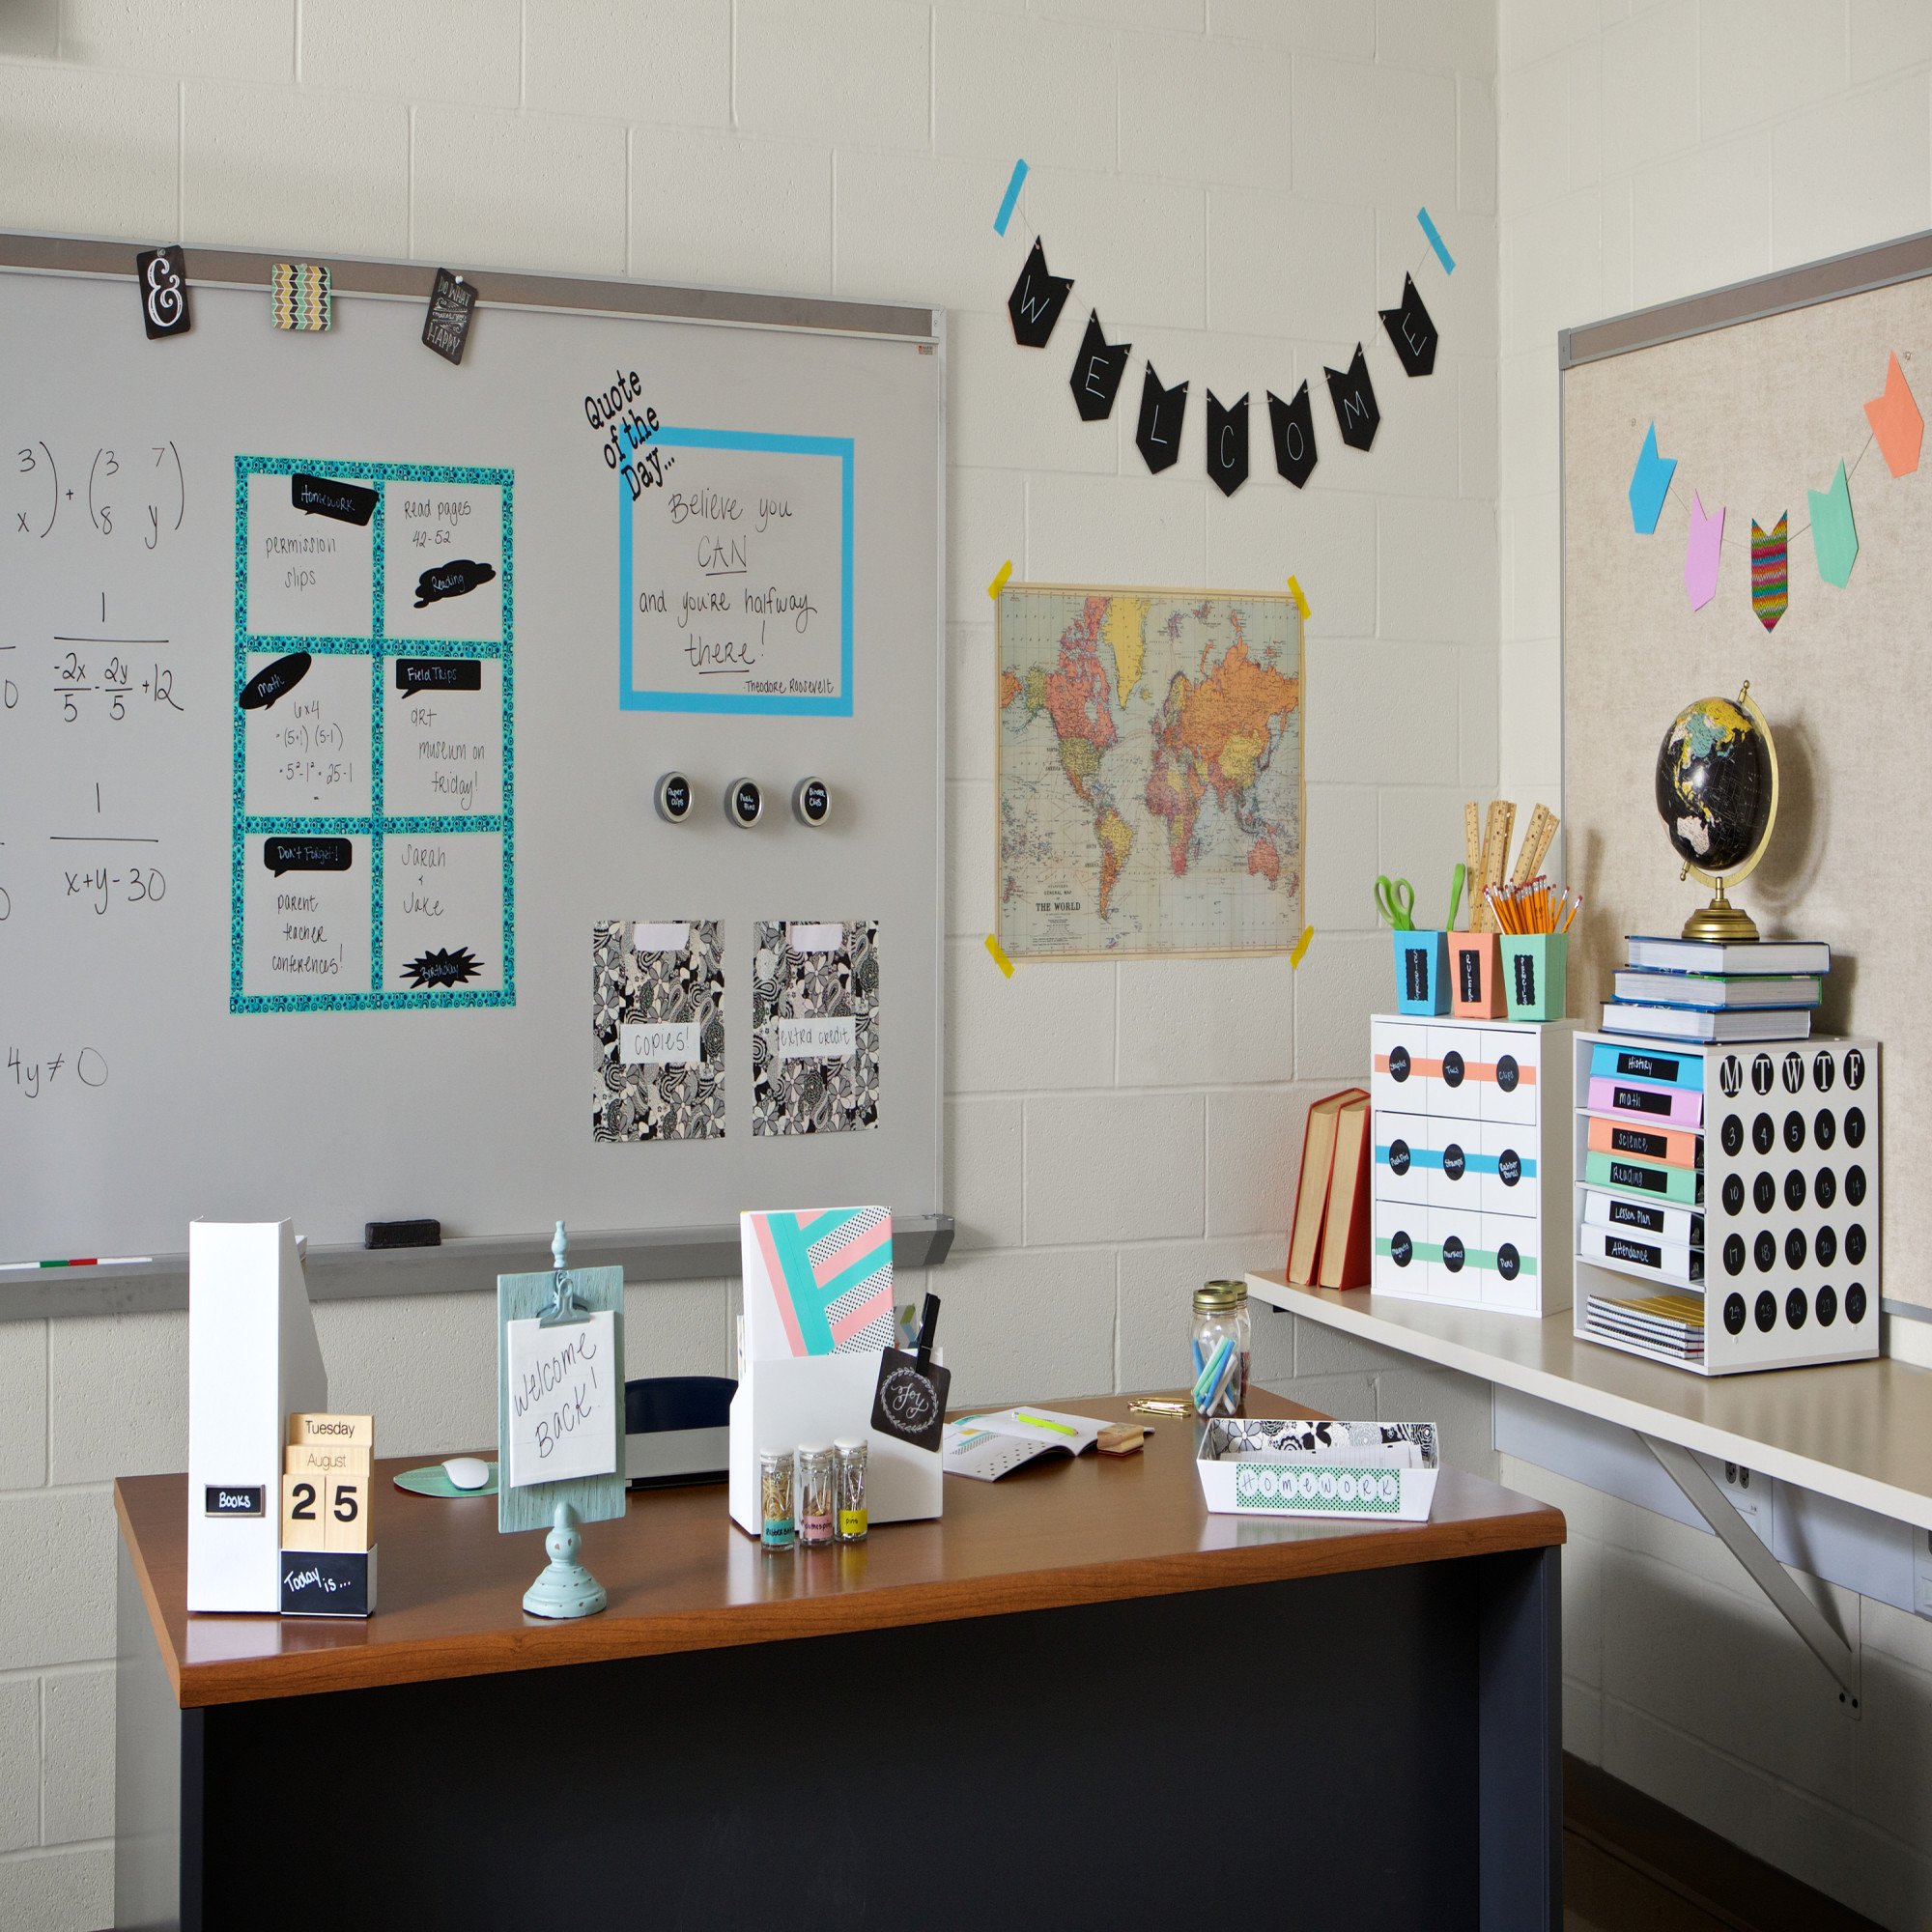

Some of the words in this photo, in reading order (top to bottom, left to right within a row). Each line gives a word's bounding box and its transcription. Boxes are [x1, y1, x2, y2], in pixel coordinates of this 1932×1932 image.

[427, 322, 461, 355] HAPPY
[583, 369, 642, 430] Quote
[604, 425, 627, 469] of
[622, 406, 660, 449] the
[438, 500, 471, 526] pages
[668, 488, 744, 524] Believe
[754, 497, 792, 533] you
[697, 535, 748, 569] CAN
[285, 564, 316, 591] slips
[639, 590, 668, 613] and
[744, 586, 818, 634] halfway
[408, 667, 431, 682] Field
[789, 678, 835, 695] Roosevelt
[1036, 902, 1051, 912] THE
[1054, 901, 1081, 911] WORLD
[635, 1028, 690, 1056] copies!
[781, 1028, 812, 1047] extra
[818, 1028, 850, 1047] credit
[514, 1332, 597, 1417] Welcome
[891, 1382, 929, 1419] Joy
[305, 1420, 355, 1438] Tuesday
[307, 1453, 347, 1470] August
[284, 1567, 321, 1592] Today
